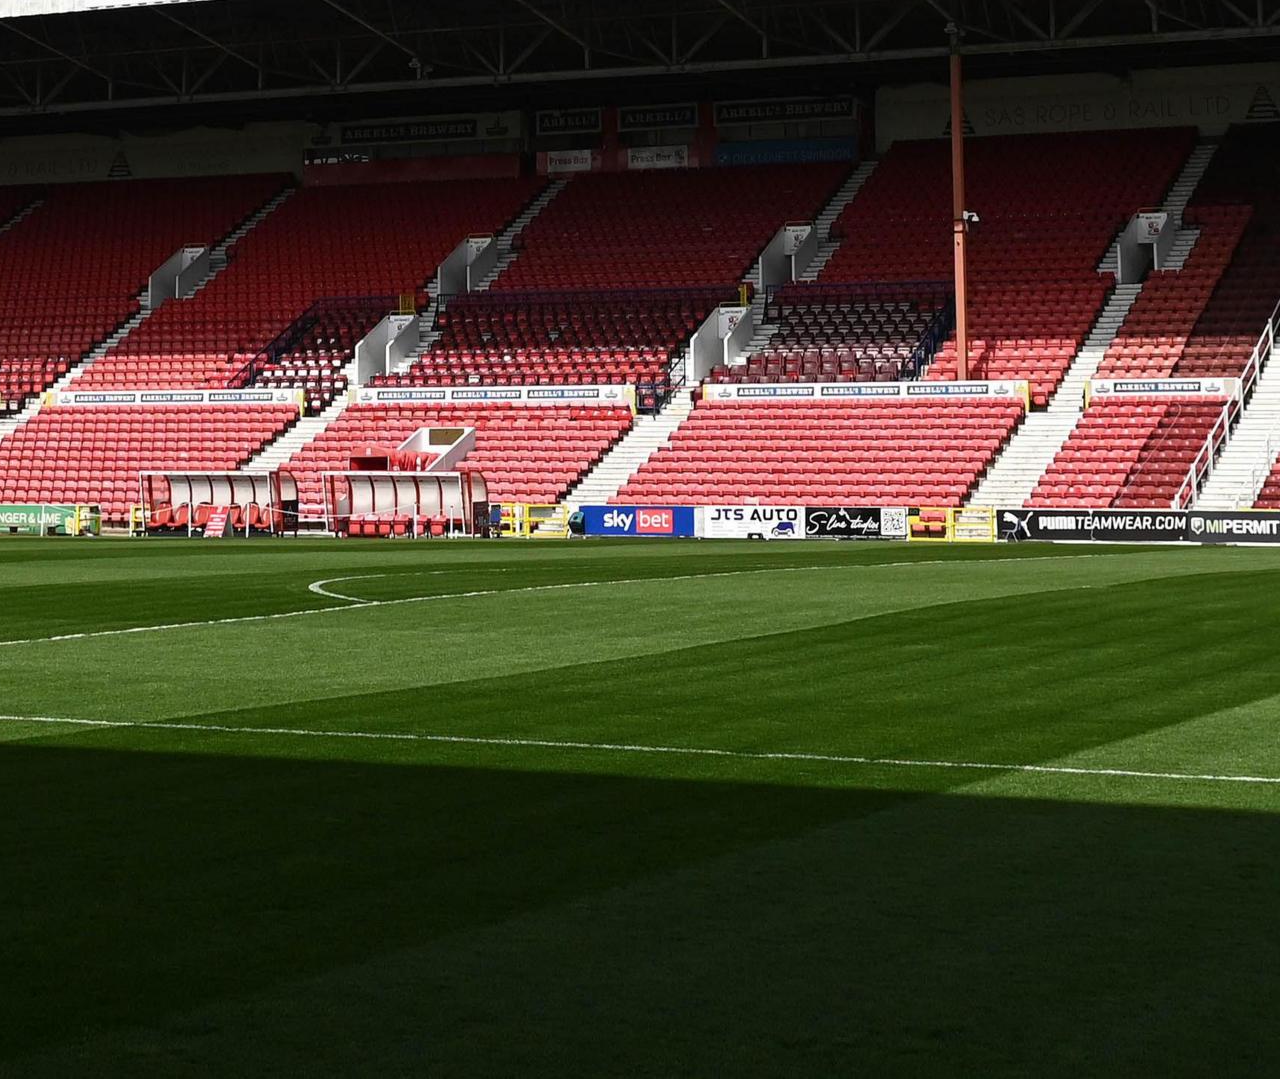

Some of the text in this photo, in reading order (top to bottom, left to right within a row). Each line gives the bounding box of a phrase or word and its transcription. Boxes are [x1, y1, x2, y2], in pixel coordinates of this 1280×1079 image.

[785, 101, 851, 115] BREWERY
[985, 105, 1025, 127] SAS
[1036, 102, 1094, 124] ROPE
[1128, 98, 1178, 118] RAIL
[1189, 95, 1232, 116] LTD
[28, 512, 36, 524] &
[603, 510, 669, 531] sky bet
[711, 509, 798, 521] JTS AUTO
[1038, 516, 1186, 530] PUMATEAMWEAR.COM
[1206, 519, 1279, 535] MIPERMIT
